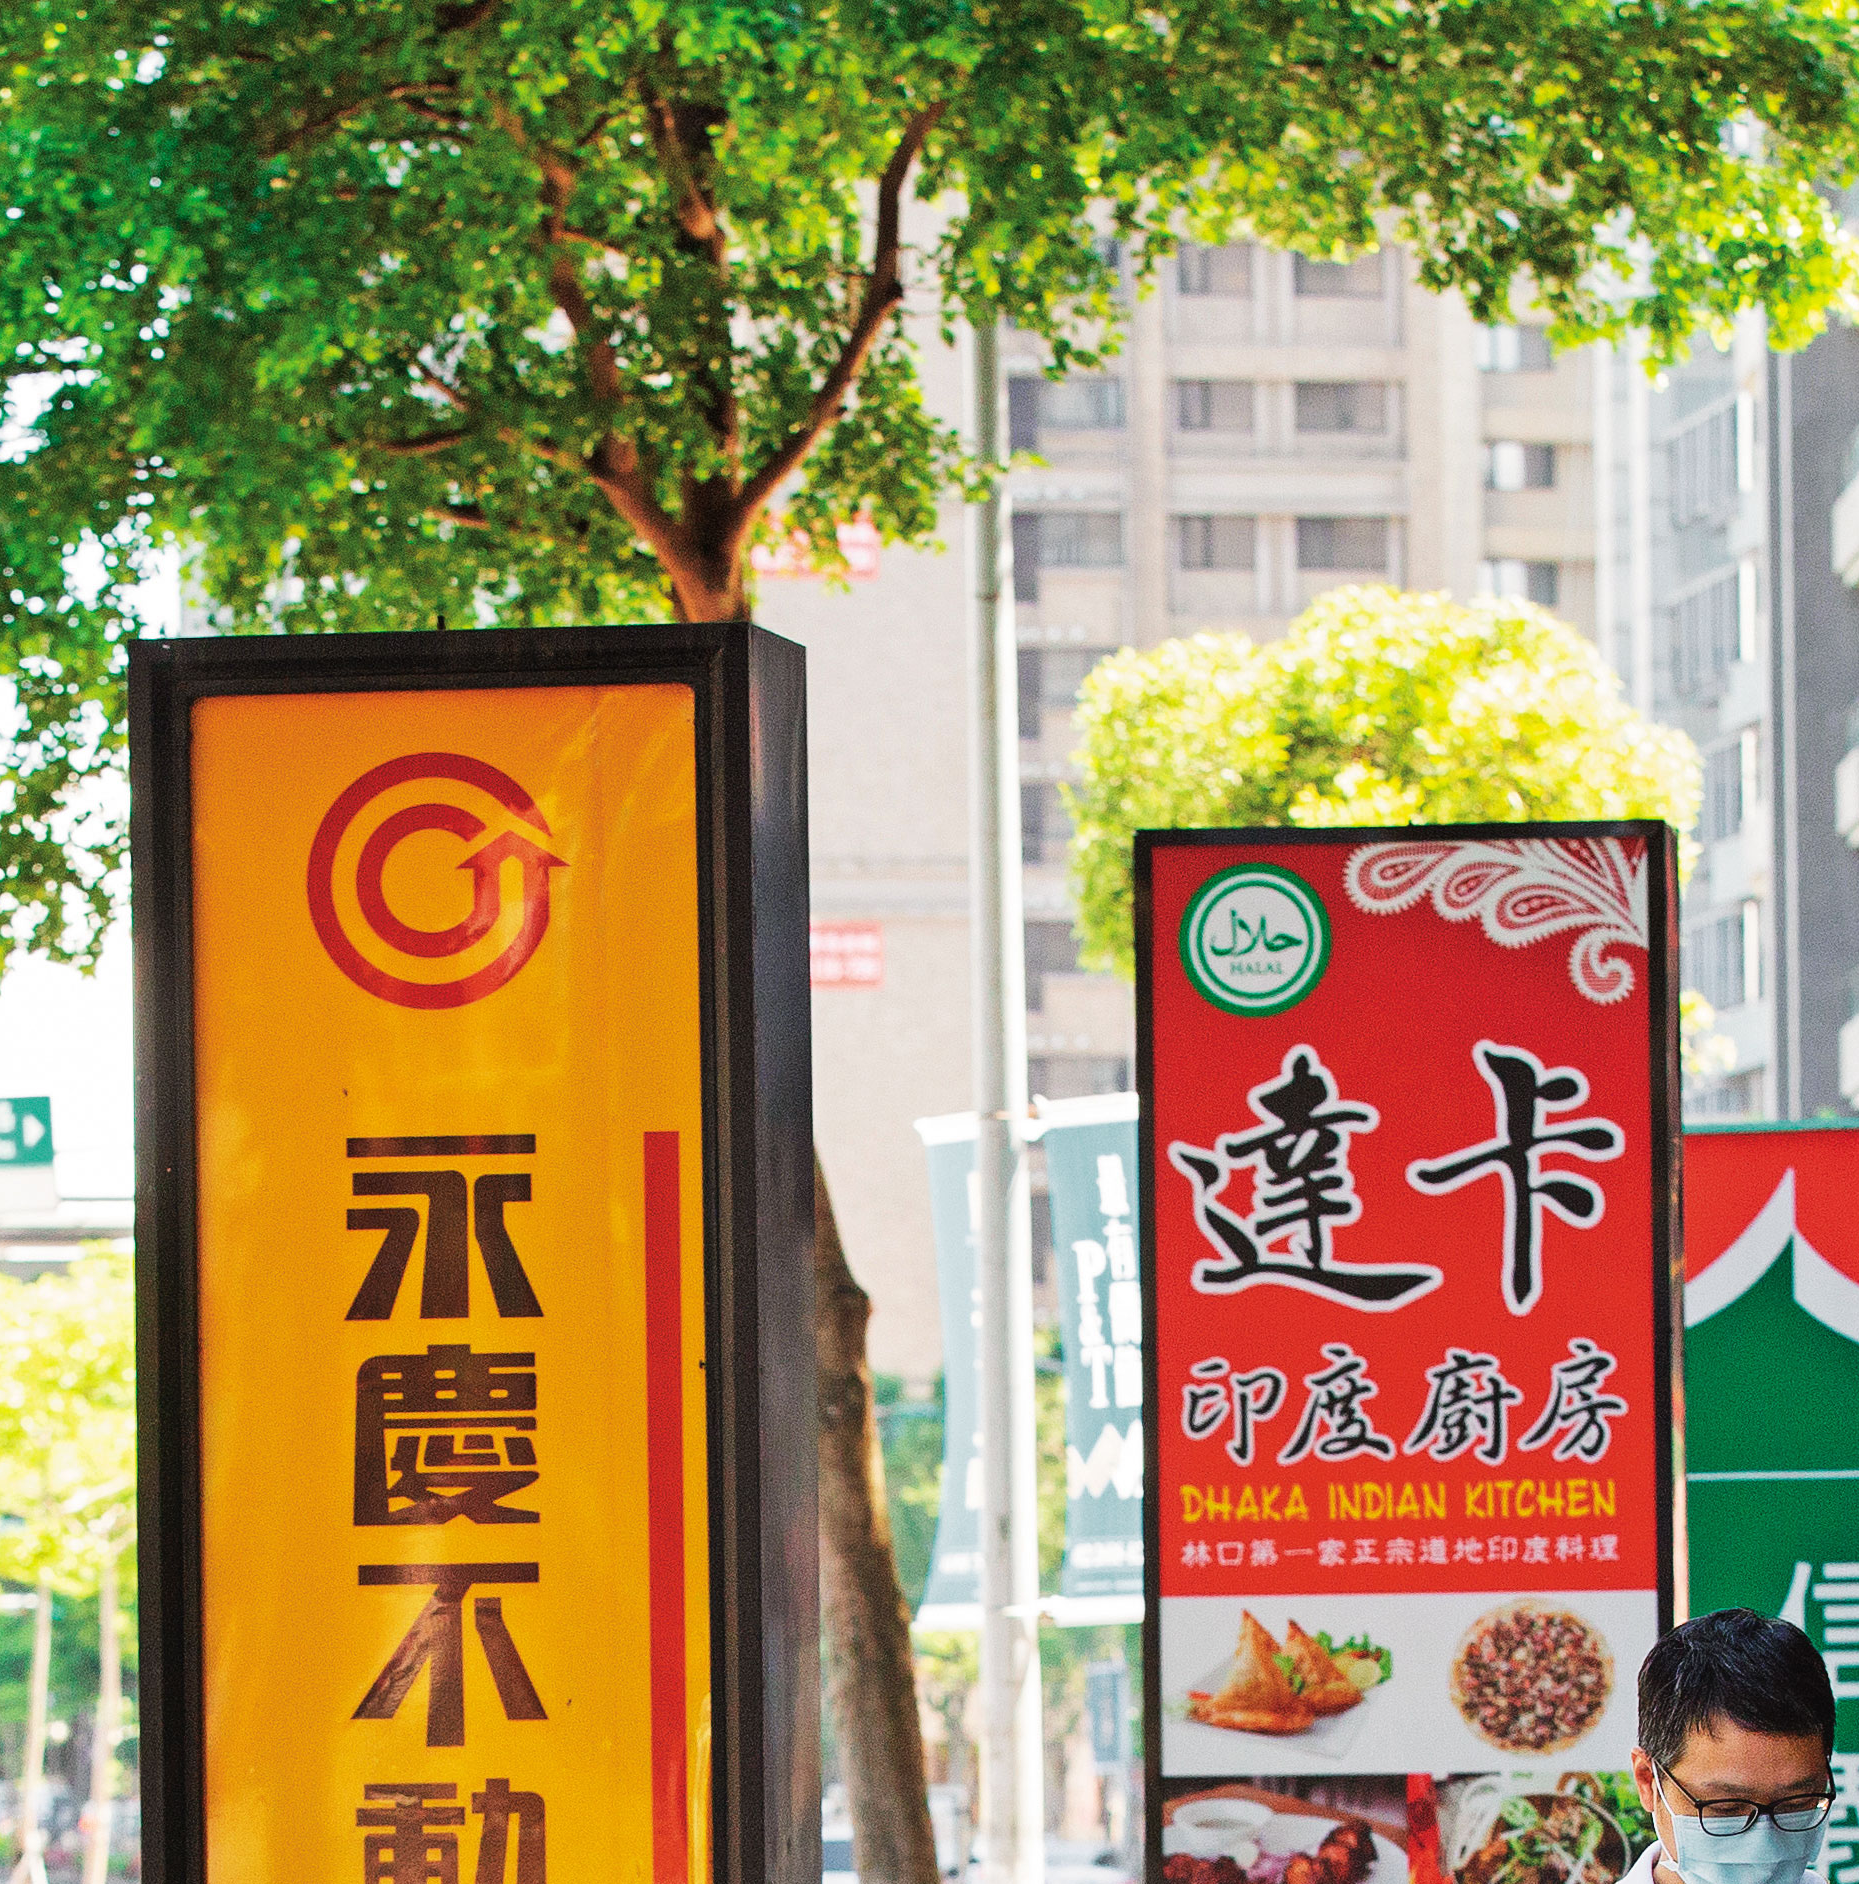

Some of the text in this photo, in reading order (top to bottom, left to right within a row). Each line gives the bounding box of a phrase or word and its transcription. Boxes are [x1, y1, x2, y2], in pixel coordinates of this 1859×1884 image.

[1209, 908, 1304, 958] حلال
[1181, 1338, 1627, 1466] 印度廚房
[1179, 1478, 1618, 1523] DHAKA INDIAN KITCHEN
